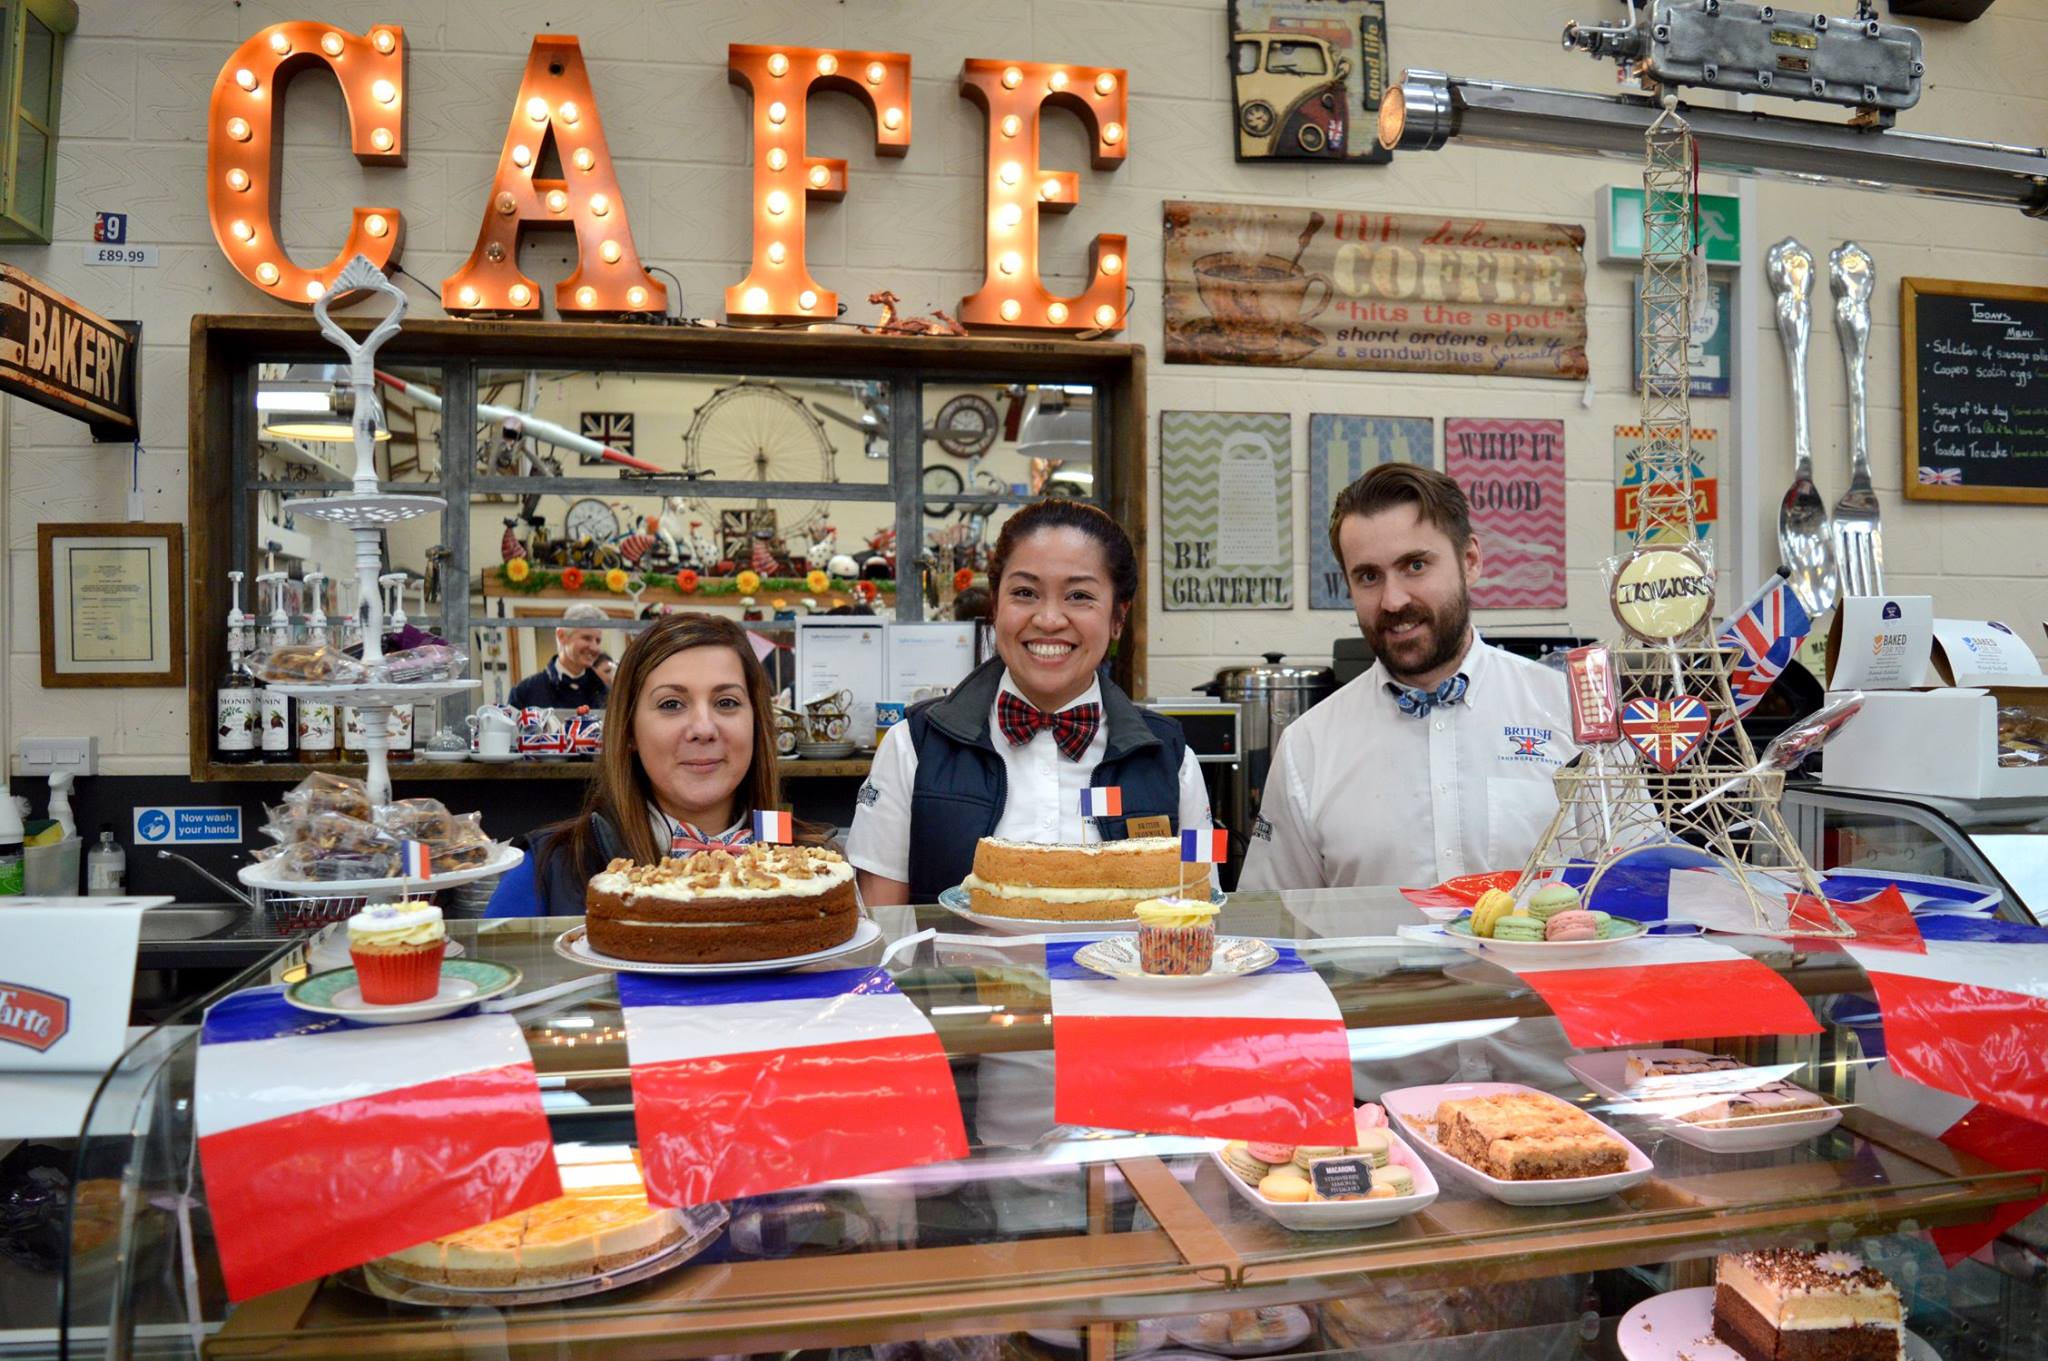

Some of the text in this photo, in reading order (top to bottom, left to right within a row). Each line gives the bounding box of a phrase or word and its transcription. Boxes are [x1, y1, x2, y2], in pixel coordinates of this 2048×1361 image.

[207, 20, 1128, 334] CAFE
[1334, 212, 1558, 256] OUR delicious
[98, 250, 145, 264] £89.99
[1333, 243, 1566, 307] COFFEE
[1423, 303, 1472, 326] the
[1336, 326, 1401, 344] short
[1409, 330, 1488, 347] orders
[27, 293, 125, 406] BAKERY
[1337, 346, 1346, 358] &
[1356, 346, 1484, 363] sandwiches
[1933, 339, 1978, 355] Selection
[1982, 345, 1993, 360] of
[1996, 350, 2030, 366] sausage
[2010, 370, 2032, 387] eggs
[1932, 402, 1958, 419] Soup
[1960, 402, 1970, 415] of
[1973, 403, 1989, 416] the
[1992, 404, 2009, 423] day
[1458, 432, 1557, 461] WHIP IT
[1933, 439, 1966, 457] Toasted
[1969, 441, 2009, 458] Teacake
[1469, 480, 1542, 512] GOOD
[1174, 541, 1211, 571] BE
[1172, 577, 1288, 607] GRATEFUL
[1883, 633, 1907, 646] BAKED
[220, 697, 251, 705] MONIN
[1504, 726, 1552, 741] BRITISH
[181, 813, 232, 823] Now wash
[178, 825, 235, 837] your hands
